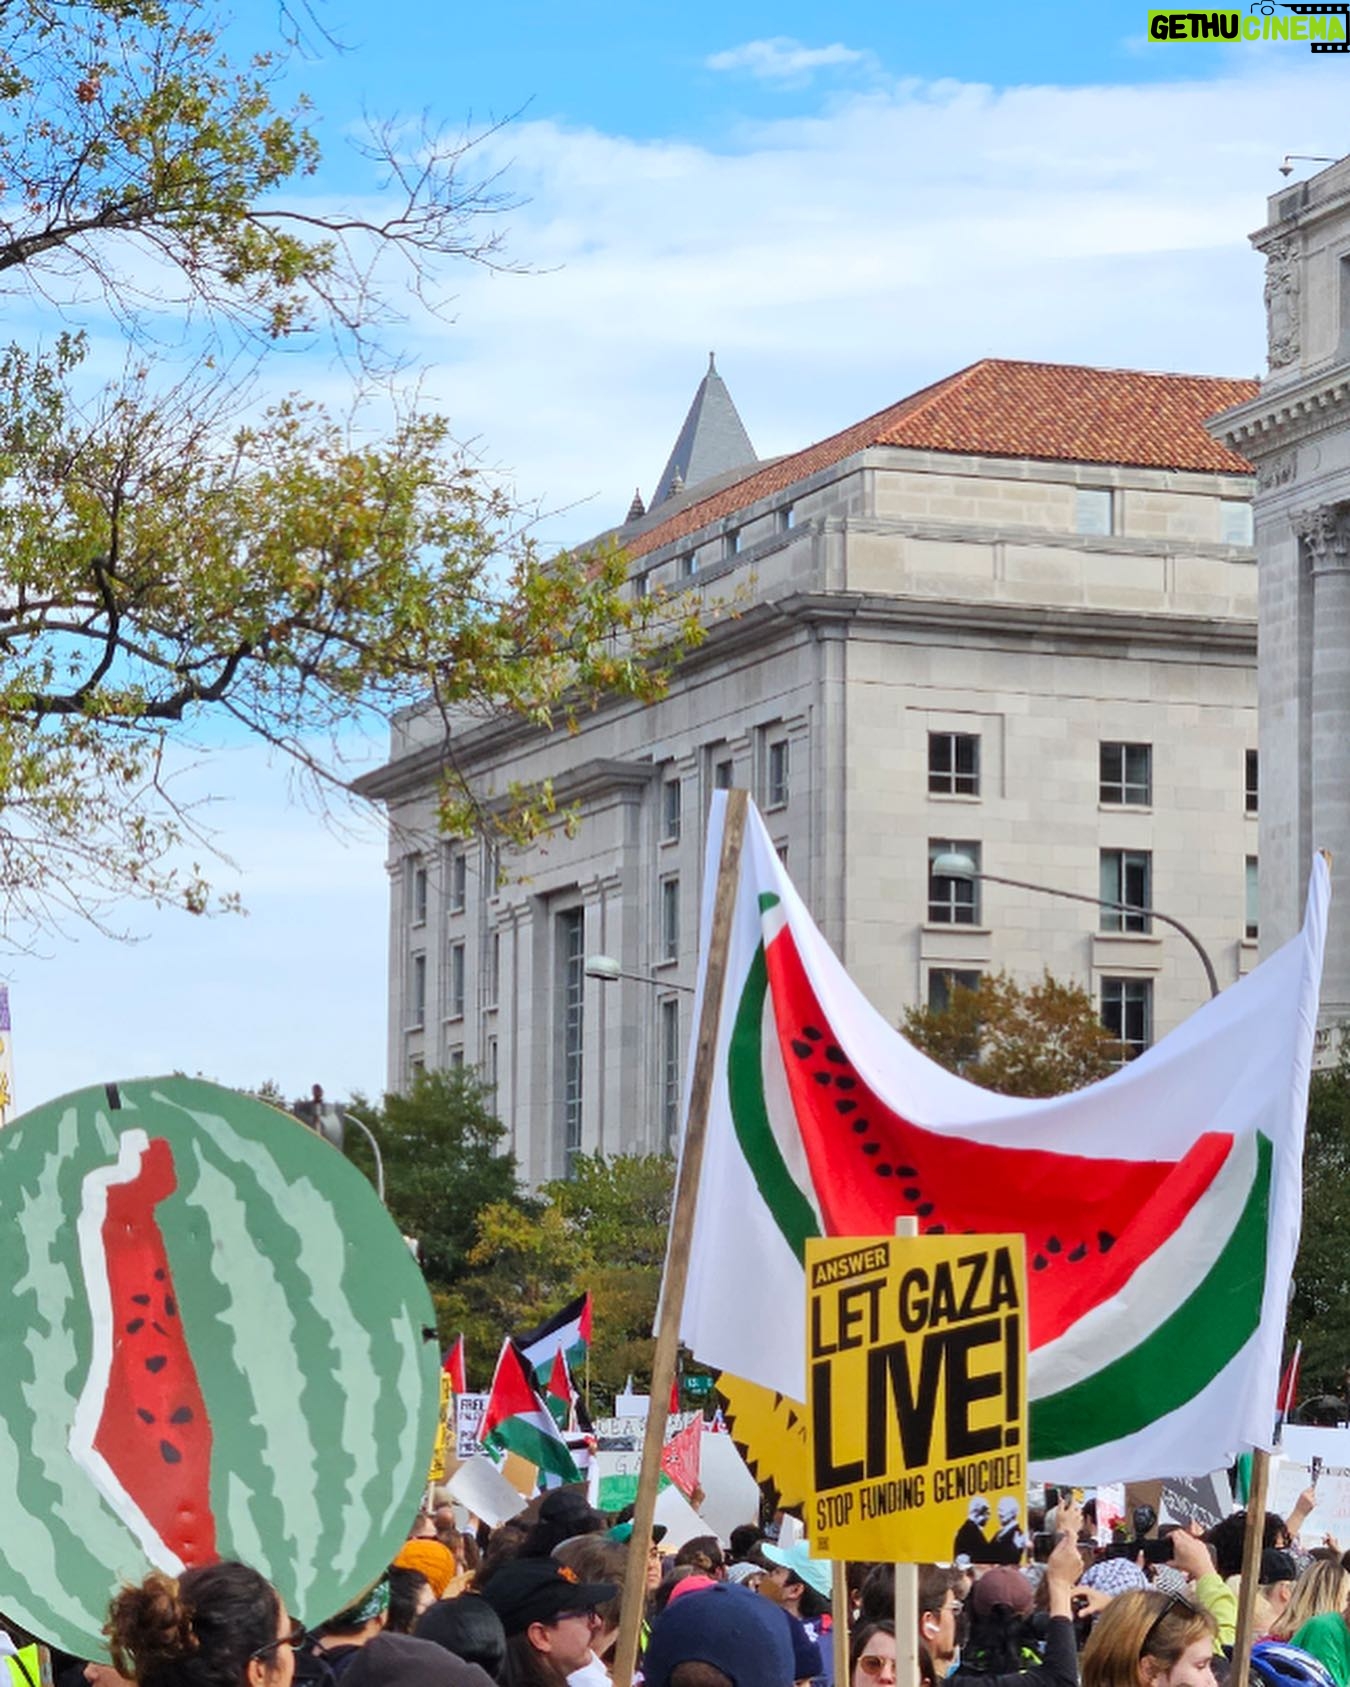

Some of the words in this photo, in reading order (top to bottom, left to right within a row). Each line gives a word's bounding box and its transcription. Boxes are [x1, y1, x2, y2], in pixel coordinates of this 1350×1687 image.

[812, 1277, 887, 1358] LET
[899, 1246, 1020, 1334] GAZA
[815, 1247, 886, 1284] ANSWER
[812, 1313, 1020, 1493] LIVE!
[816, 1491, 853, 1532] STOP
[859, 1474, 925, 1521] FUNDING
[933, 1453, 1021, 1505] GENOCIDE!
